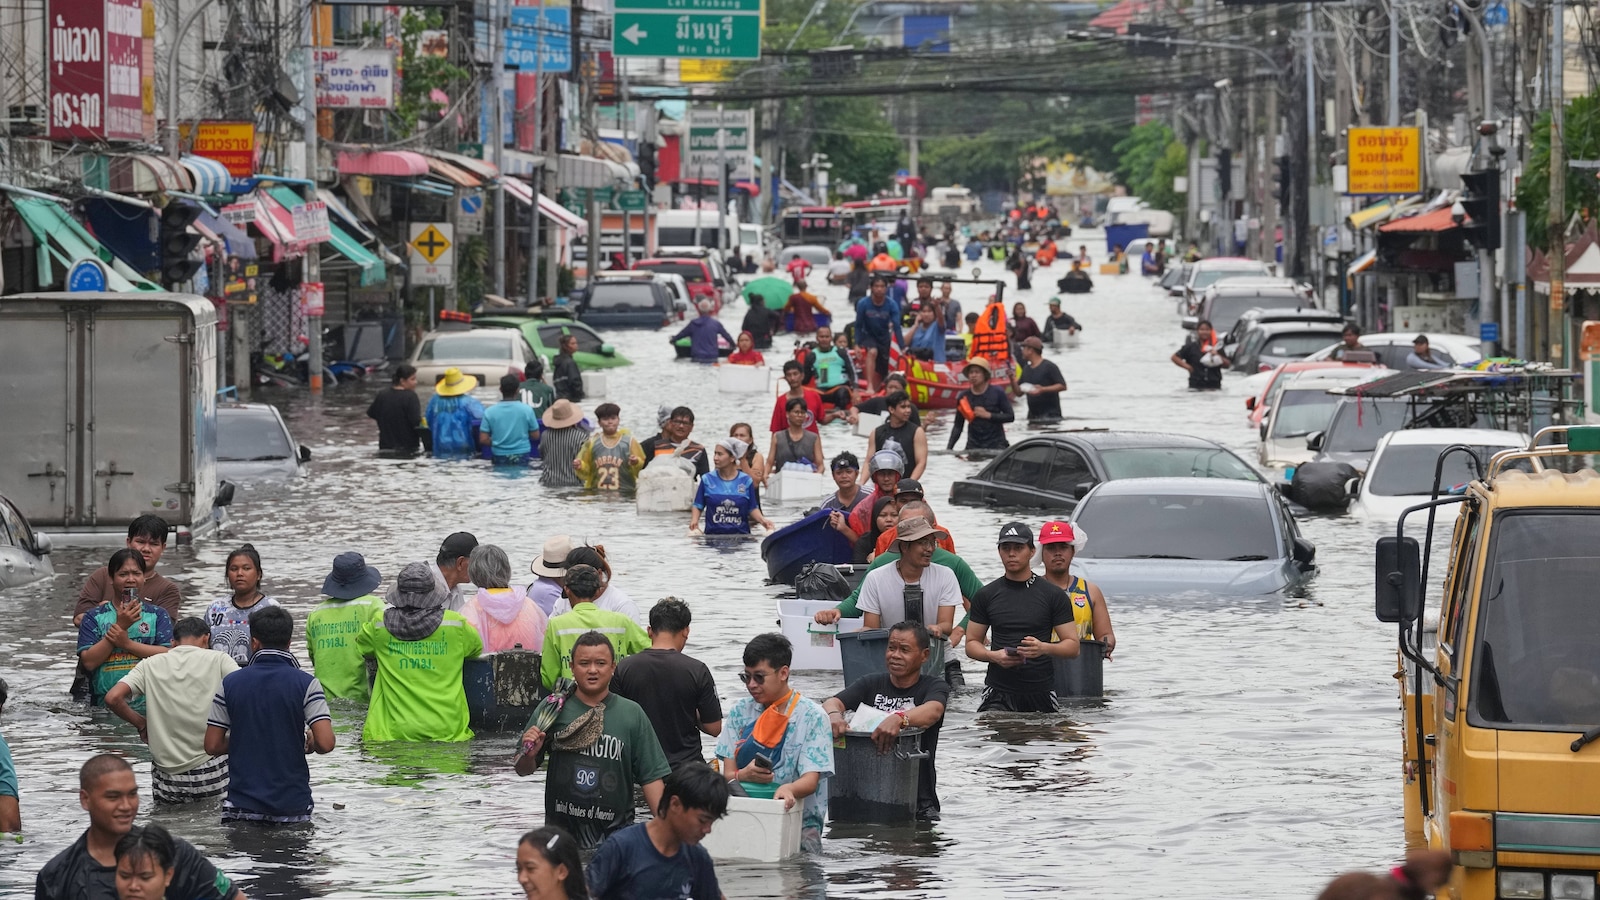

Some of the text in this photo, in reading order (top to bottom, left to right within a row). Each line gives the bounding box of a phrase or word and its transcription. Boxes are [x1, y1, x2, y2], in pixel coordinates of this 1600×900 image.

[693, 0, 741, 9] Krabang
[675, 15, 733, 46] มีนบุรี
[53, 14, 100, 76] มุ้งลวด
[677, 45, 731, 55] Min Buri
[331, 68, 353, 77] DVD
[53, 92, 100, 129] กระจก
[594, 455, 623, 468] JORDAN
[597, 467, 620, 490] 23
[712, 513, 742, 526] Chang
[211, 613, 224, 626] 30
[317, 637, 348, 650] กทม.
[399, 658, 436, 670] กทม.
[576, 769, 596, 786] DC
[568, 802, 586, 818] States
[587, 805, 595, 819] of
